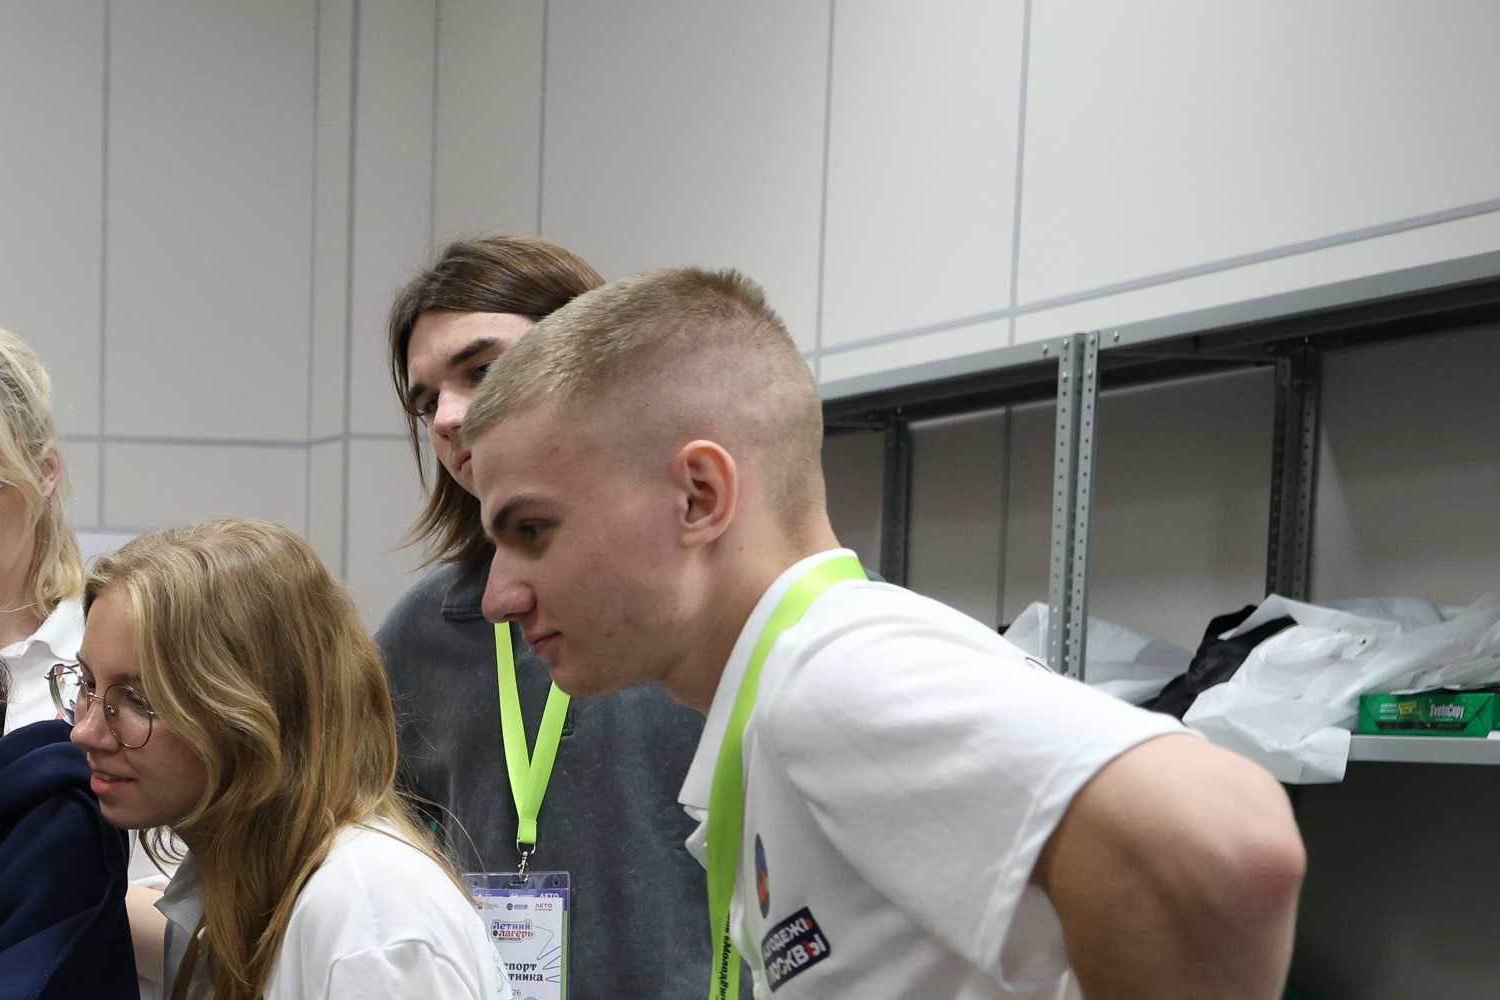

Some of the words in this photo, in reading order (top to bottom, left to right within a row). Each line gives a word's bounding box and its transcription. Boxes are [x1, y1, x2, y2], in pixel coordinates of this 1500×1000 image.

[1429, 703, 1465, 719] SvetoCopy
[493, 921, 531, 930] Летний
[499, 930, 534, 939] лагерь
[503, 962, 537, 972] спорт
[508, 973, 543, 981] тника
